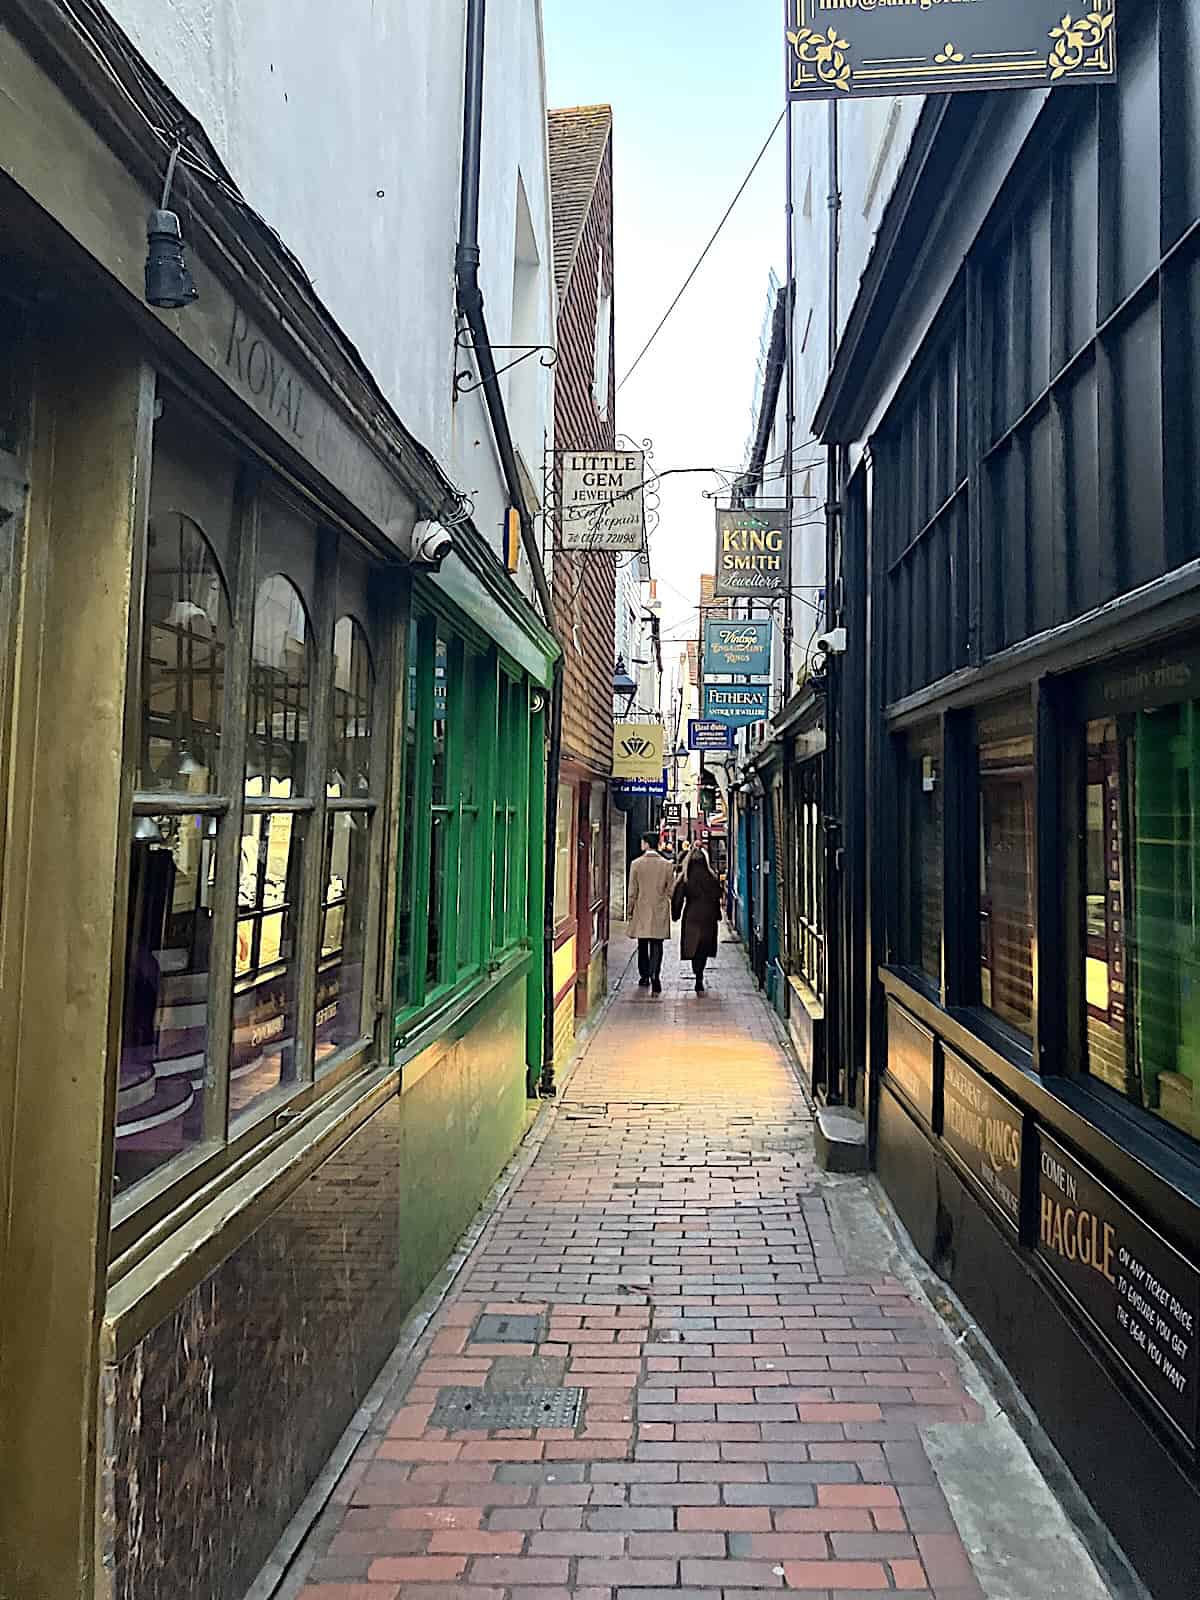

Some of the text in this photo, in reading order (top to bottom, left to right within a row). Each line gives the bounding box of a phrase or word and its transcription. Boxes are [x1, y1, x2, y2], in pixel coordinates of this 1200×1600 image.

[227, 308, 303, 439] ROYAL
[572, 457, 636, 471] LITTLE
[582, 472, 623, 487] GEM
[723, 529, 783, 552] KING
[723, 554, 780, 569] SMITH
[720, 627, 758, 649] Vintage
[709, 689, 764, 704] FETHERAY
[985, 1117, 1019, 1171] RINGS
[1041, 1151, 1078, 1203] COME IN
[1040, 1193, 1116, 1282] HAGGLE
[1119, 1248, 1130, 1266] ON
[1130, 1259, 1145, 1281] ANY
[1145, 1273, 1170, 1308] TICKET
[1118, 1276, 1188, 1360] TO ENSURE YOU GET
[1117, 1305, 1186, 1393] THE DEAL YOU WANT
